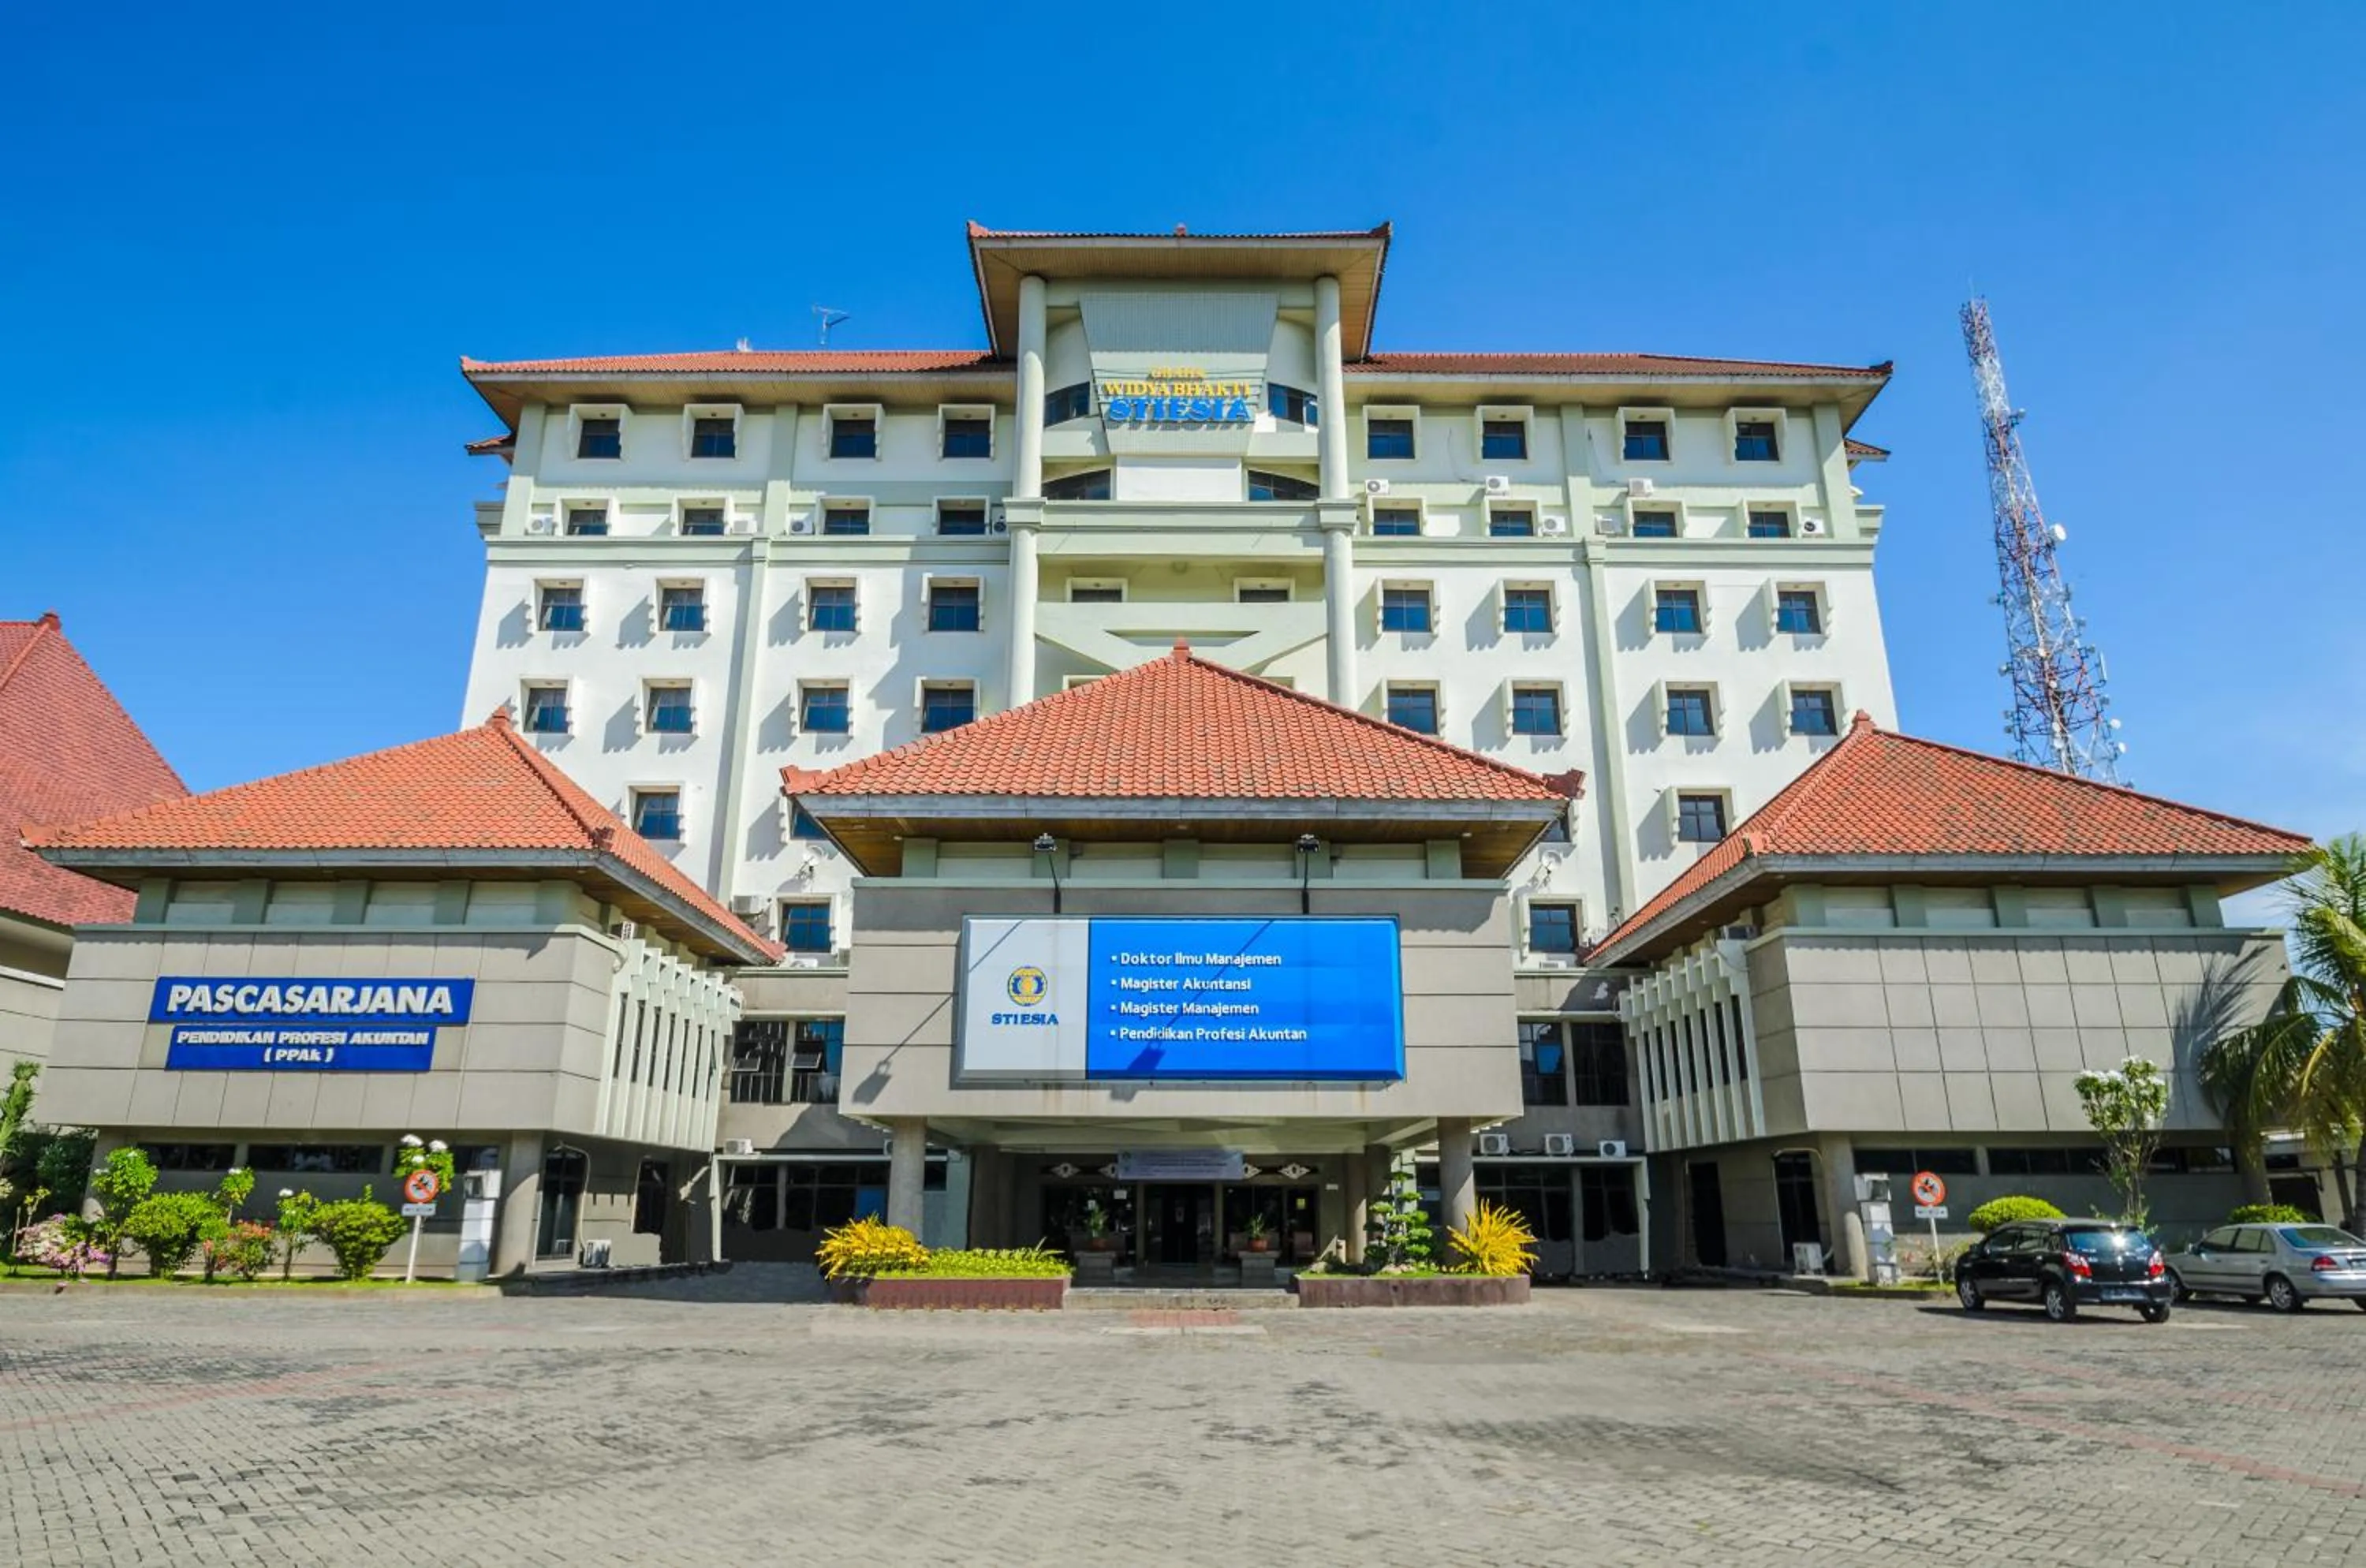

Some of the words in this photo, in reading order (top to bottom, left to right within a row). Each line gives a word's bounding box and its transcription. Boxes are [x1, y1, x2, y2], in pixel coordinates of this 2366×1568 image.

[1109, 397, 1251, 421] STIESIA
[1121, 953, 1172, 965] Doktor
[1174, 953, 1203, 965] Ilmu
[1206, 954, 1282, 967] Manajemen
[1121, 978, 1178, 992] Magister
[1183, 978, 1251, 991] Akuntansi
[166, 985, 453, 1013] PASCASARJANA
[1121, 1002, 1178, 1017] Magister
[1182, 1002, 1260, 1017] Manajemen
[991, 1013, 1059, 1025] STIESIA
[177, 1031, 275, 1043] PENDIDIKAN
[278, 1032, 348, 1044] PROFESI
[349, 1032, 431, 1045] AKUNTAN
[1119, 1028, 1193, 1040] Pendidikan
[1196, 1029, 1245, 1040] Profesi
[1248, 1029, 1307, 1040] Akuntan
